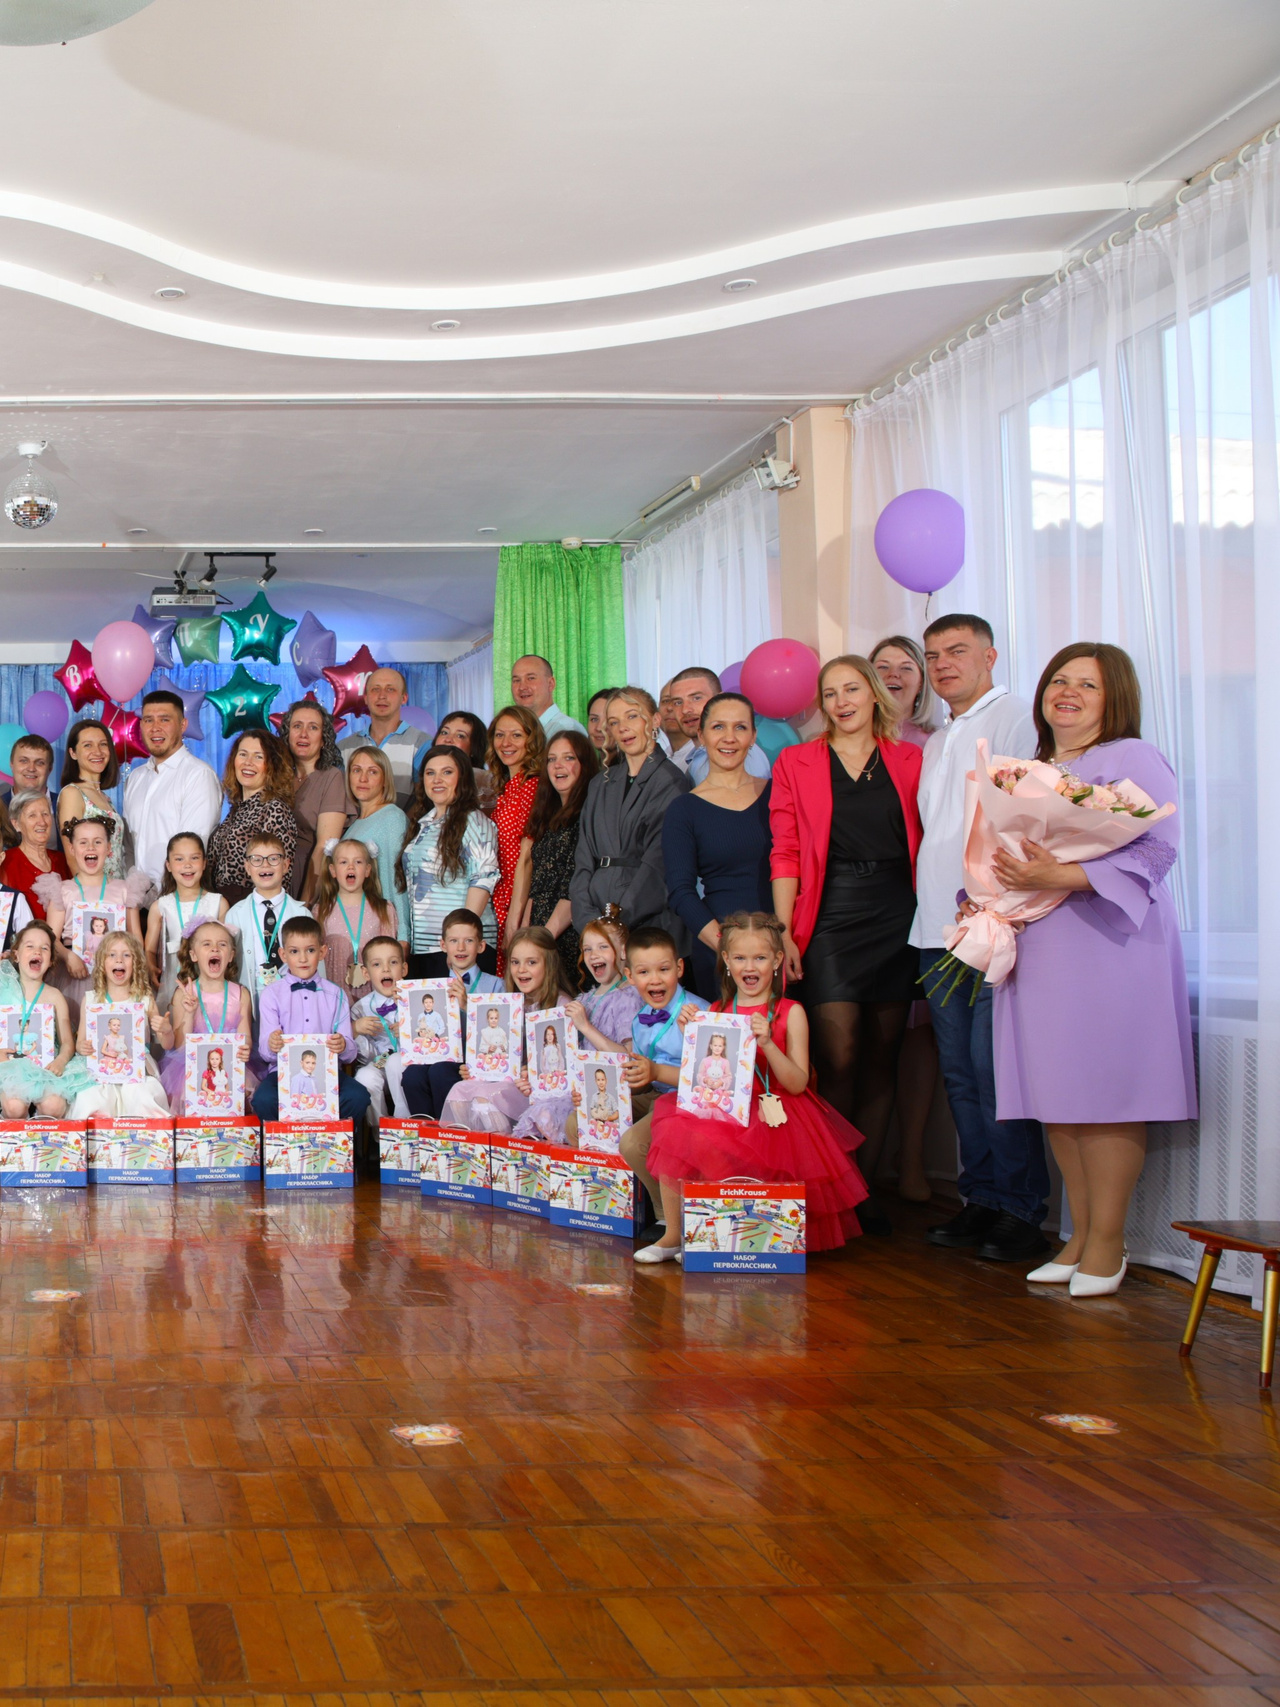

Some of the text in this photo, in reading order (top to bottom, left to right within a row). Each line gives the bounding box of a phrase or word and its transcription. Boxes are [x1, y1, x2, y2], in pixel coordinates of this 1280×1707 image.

[291, 1124, 326, 1132] ErichKrause
[438, 1131, 466, 1140] ErichKrause
[508, 1140, 533, 1150] ErichKrause
[574, 1154, 606, 1165] ErichKrause
[448, 1184, 463, 1192] НАБОР
[437, 1190, 475, 1199] ПЕРВОКЛАССНИКА
[517, 1196, 530, 1204] НАБОР
[506, 1201, 541, 1213] ПЕРВОКЛАССНИКА
[582, 1214, 600, 1222] НАБОР
[569, 1218, 614, 1231] ПЕРВОКЛАССНИКА
[713, 1262, 777, 1270] ПЕРВОКЛАССНИКА
